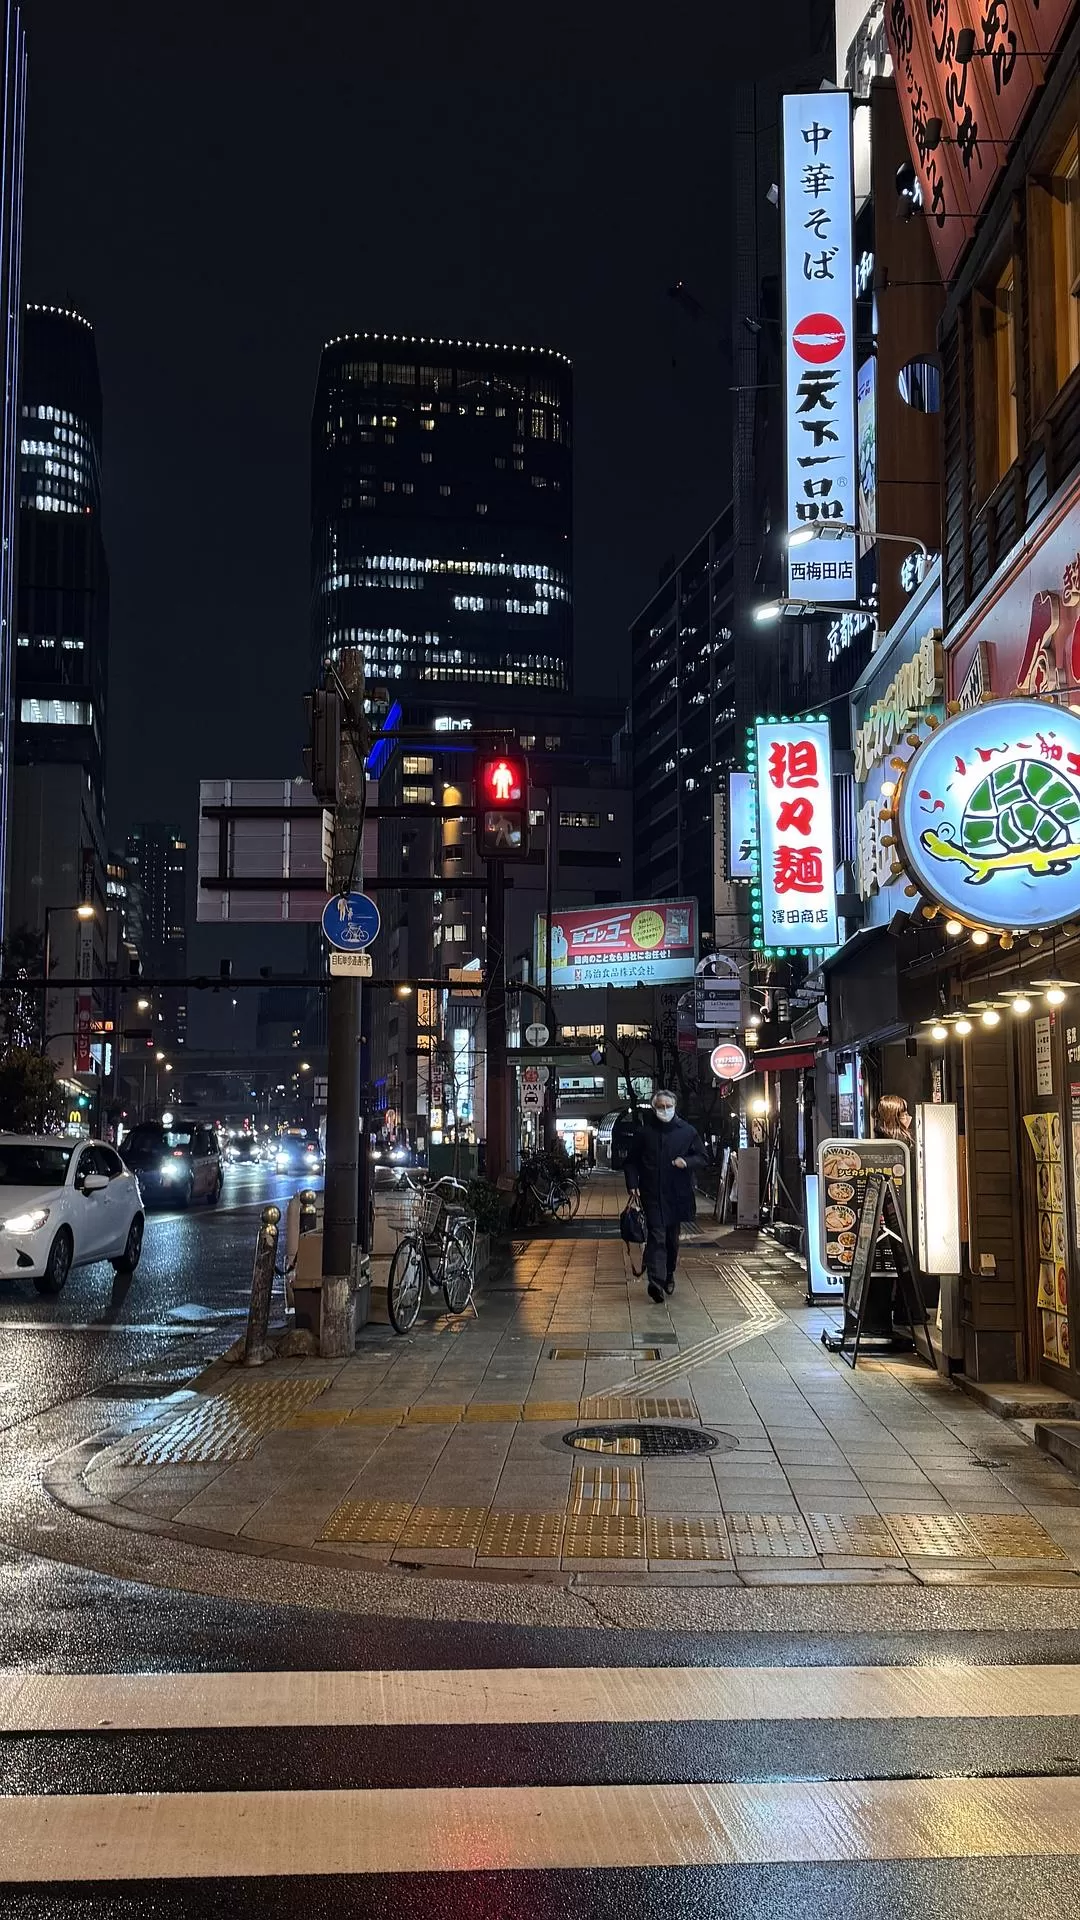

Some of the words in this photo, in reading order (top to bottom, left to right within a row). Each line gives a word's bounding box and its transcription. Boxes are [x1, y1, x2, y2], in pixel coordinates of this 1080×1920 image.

[800, 121, 839, 281] 中華そば
[795, 368, 847, 522] 天下一品
[791, 560, 853, 582] 西梅田店
[768, 740, 824, 895] 担々麺
[772, 909, 829, 924] 澤田商店
